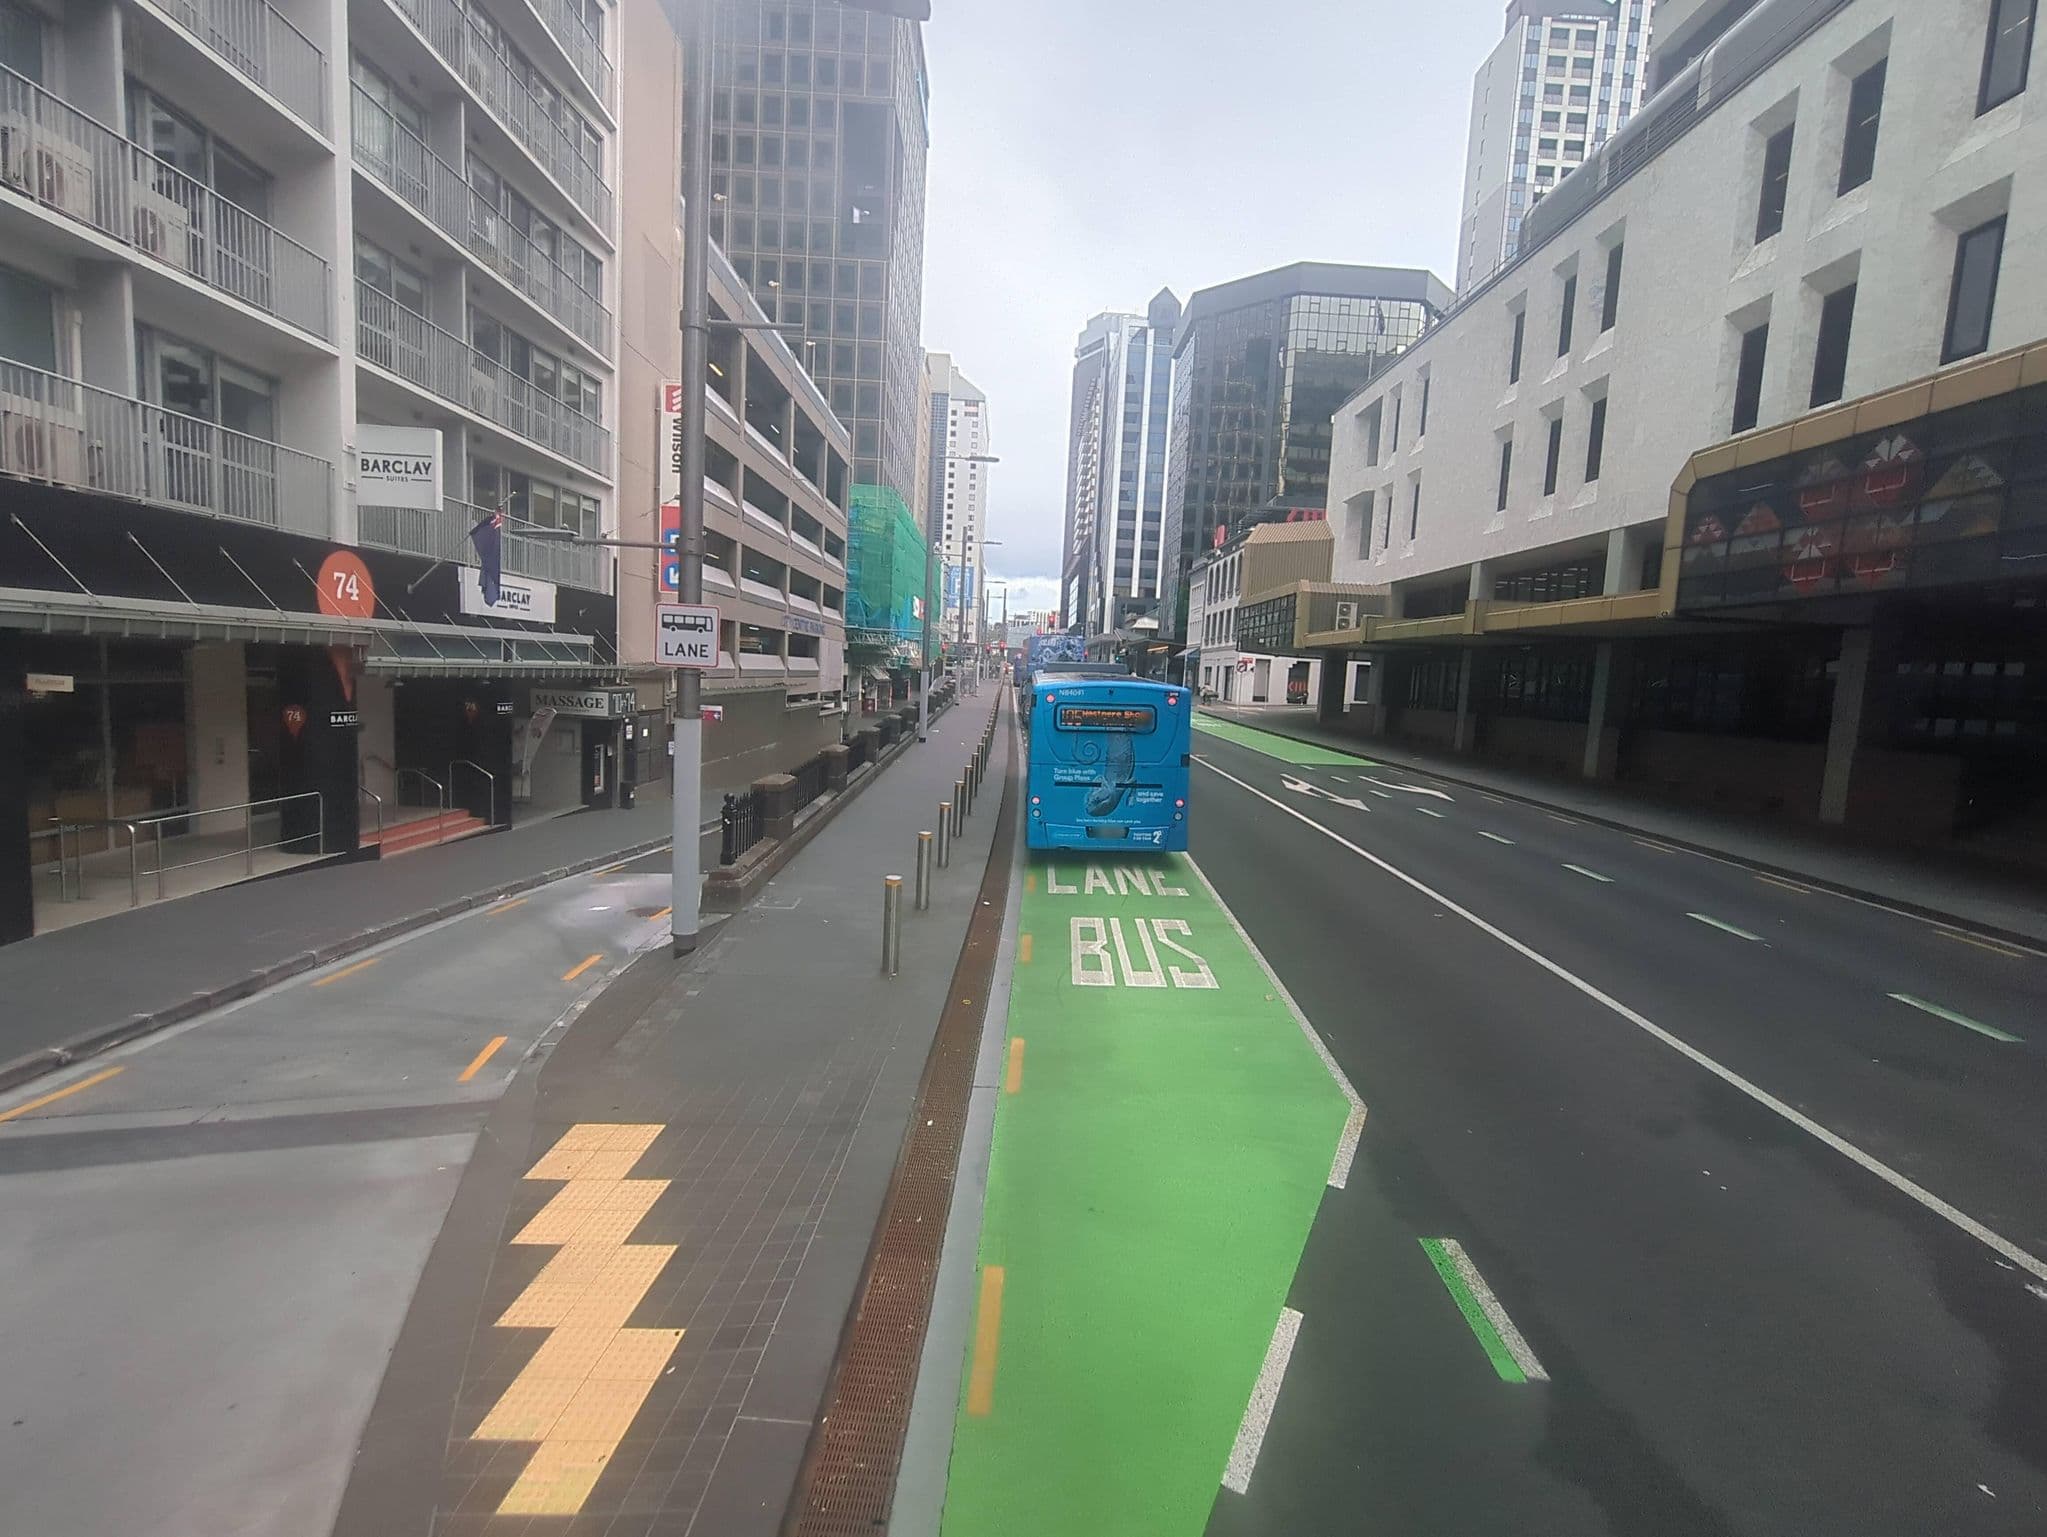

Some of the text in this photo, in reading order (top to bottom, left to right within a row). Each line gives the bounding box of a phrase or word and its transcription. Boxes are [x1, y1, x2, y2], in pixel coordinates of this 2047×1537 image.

[361, 458, 432, 475] BARCLAY
[333, 571, 360, 601] 74
[499, 590, 531, 606] ARCLAY
[664, 641, 709, 658] LANE
[535, 694, 604, 710] MASSAGE
[1047, 861, 1190, 897] LANE
[1070, 917, 1220, 989] BUS
